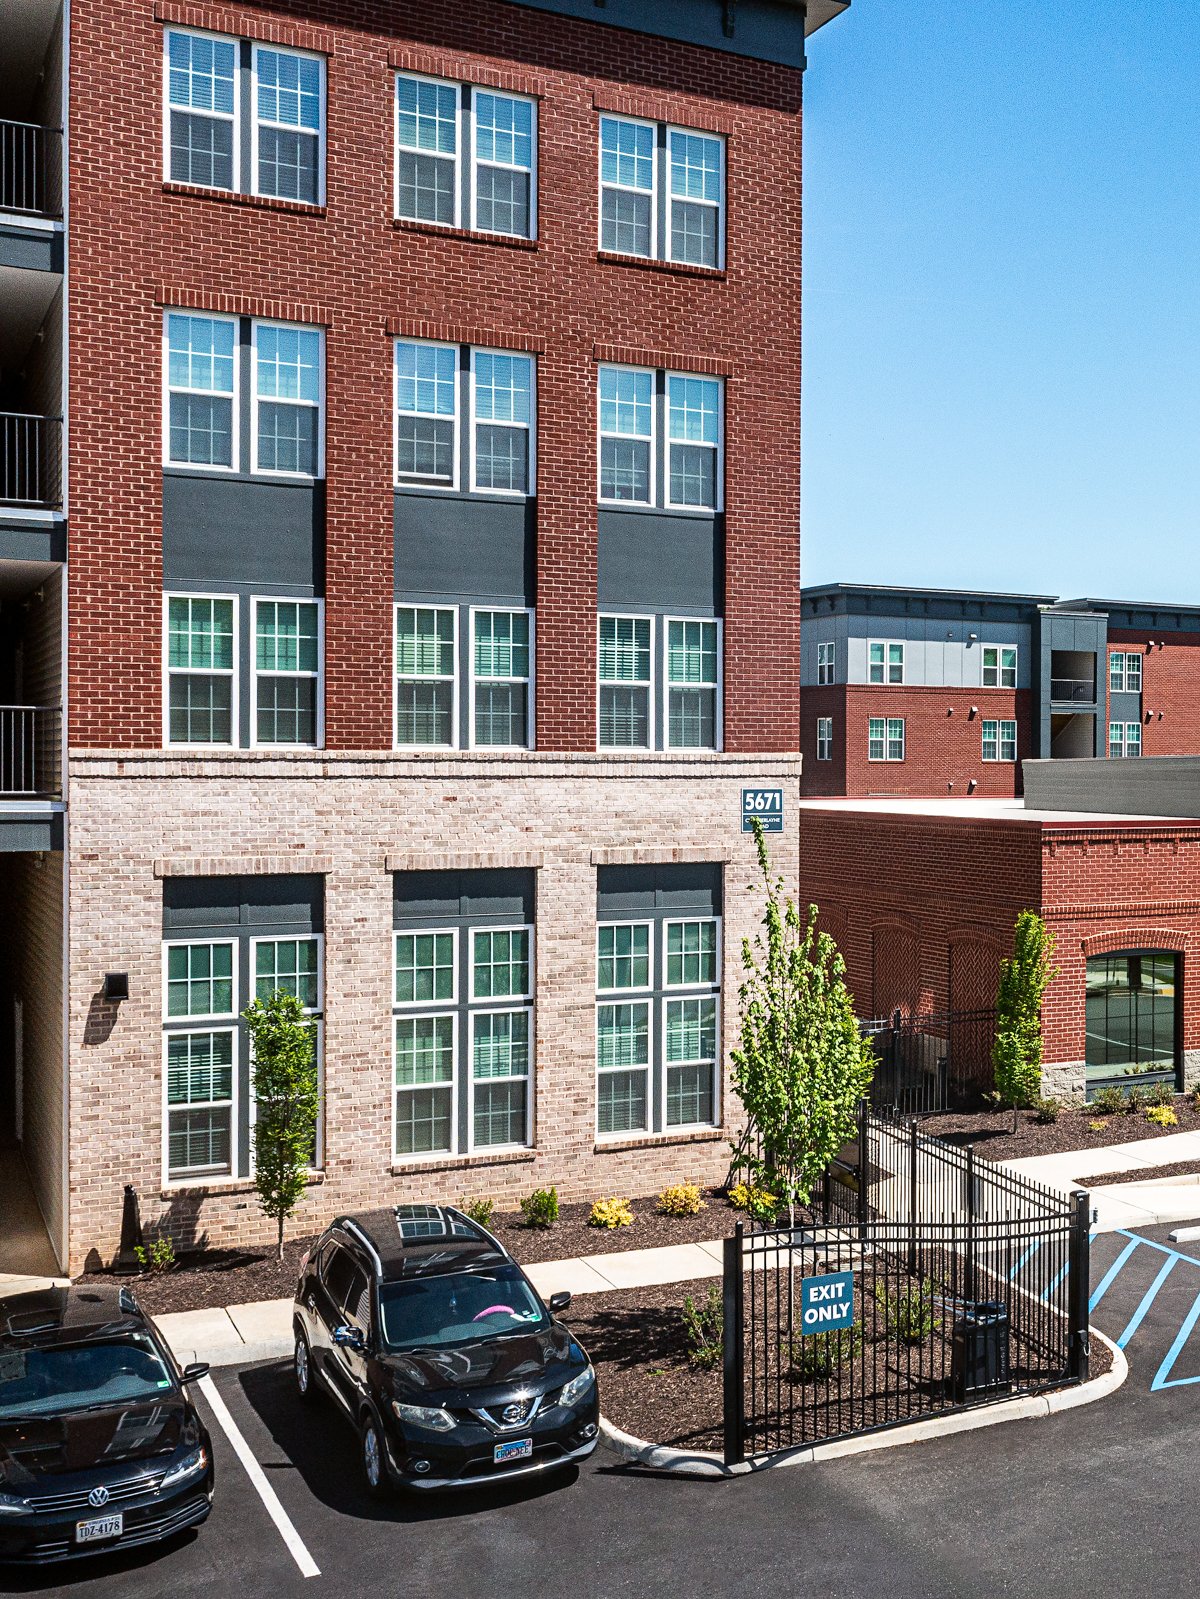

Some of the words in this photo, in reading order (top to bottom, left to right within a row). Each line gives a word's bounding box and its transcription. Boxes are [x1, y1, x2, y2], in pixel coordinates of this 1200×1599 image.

[745, 792, 781, 811] 5671
[809, 1282, 846, 1303] EXIT
[804, 1301, 851, 1324] ONLY
[80, 1521, 120, 1537] TDZ-4178
